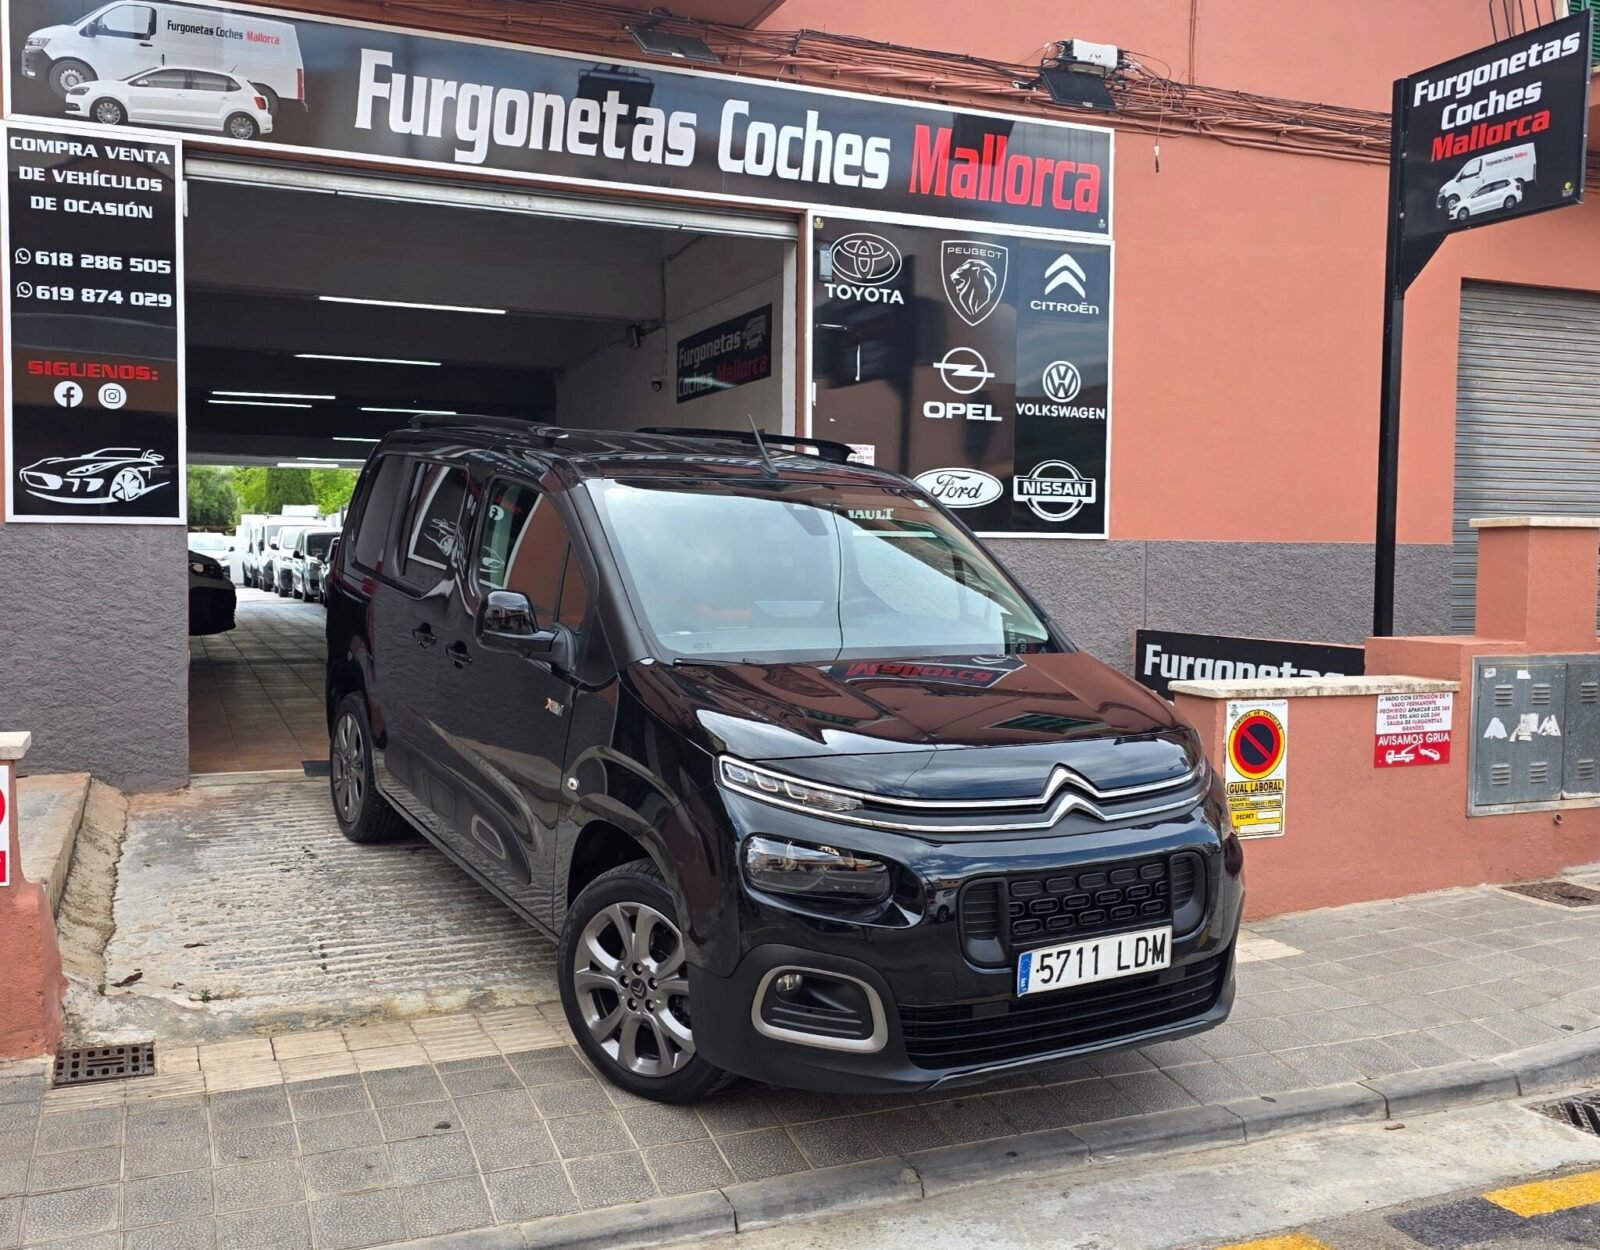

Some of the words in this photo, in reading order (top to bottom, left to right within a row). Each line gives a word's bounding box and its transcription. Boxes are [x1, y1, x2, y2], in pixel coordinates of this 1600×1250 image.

[167, 20, 213, 35] Furgonetas
[216, 27, 243, 39] Coches
[246, 31, 280, 44] Mallorca
[1413, 32, 1580, 107] Furgonetas
[1441, 81, 1542, 130] Coches
[354, 48, 697, 167] Furgonetas
[718, 99, 891, 190] Coches
[909, 124, 1101, 213] Mallorca
[1431, 110, 1550, 162] Mallorca
[10, 136, 98, 158] COMPRA
[105, 145, 170, 165] VENTA
[19, 166, 46, 182] DE
[52, 169, 163, 192] VEHÍCULOS
[30, 196, 57, 211] DE
[64, 199, 153, 219] OCASIÓN
[35, 251, 73, 267] 618
[81, 254, 123, 271] 286
[130, 258, 171, 274] 505
[947, 247, 1003, 259] PEUGEOT
[36, 287, 74, 301] 619
[81, 289, 123, 305] 874
[130, 292, 172, 308] 029
[824, 283, 904, 304] TOYOTA
[679, 331, 741, 368] Furgonetas
[28, 361, 158, 381] SIGUENOS:
[716, 355, 768, 383] Mallorca
[923, 401, 1002, 421] OPEL
[1016, 403, 1105, 420] VOLKSWAGEN
[931, 474, 982, 499] Ford
[1023, 481, 1086, 496] NISSAN
[1144, 644, 1345, 680] Furgonet
[1378, 734, 1424, 746] AVISAMOS
[1426, 732, 1450, 743] GRUA
[1230, 784, 1248, 793] GUAL
[1250, 781, 1281, 792] LABORAL
[1038, 945, 1099, 984] 5711
[1117, 933, 1166, 971] LDM
